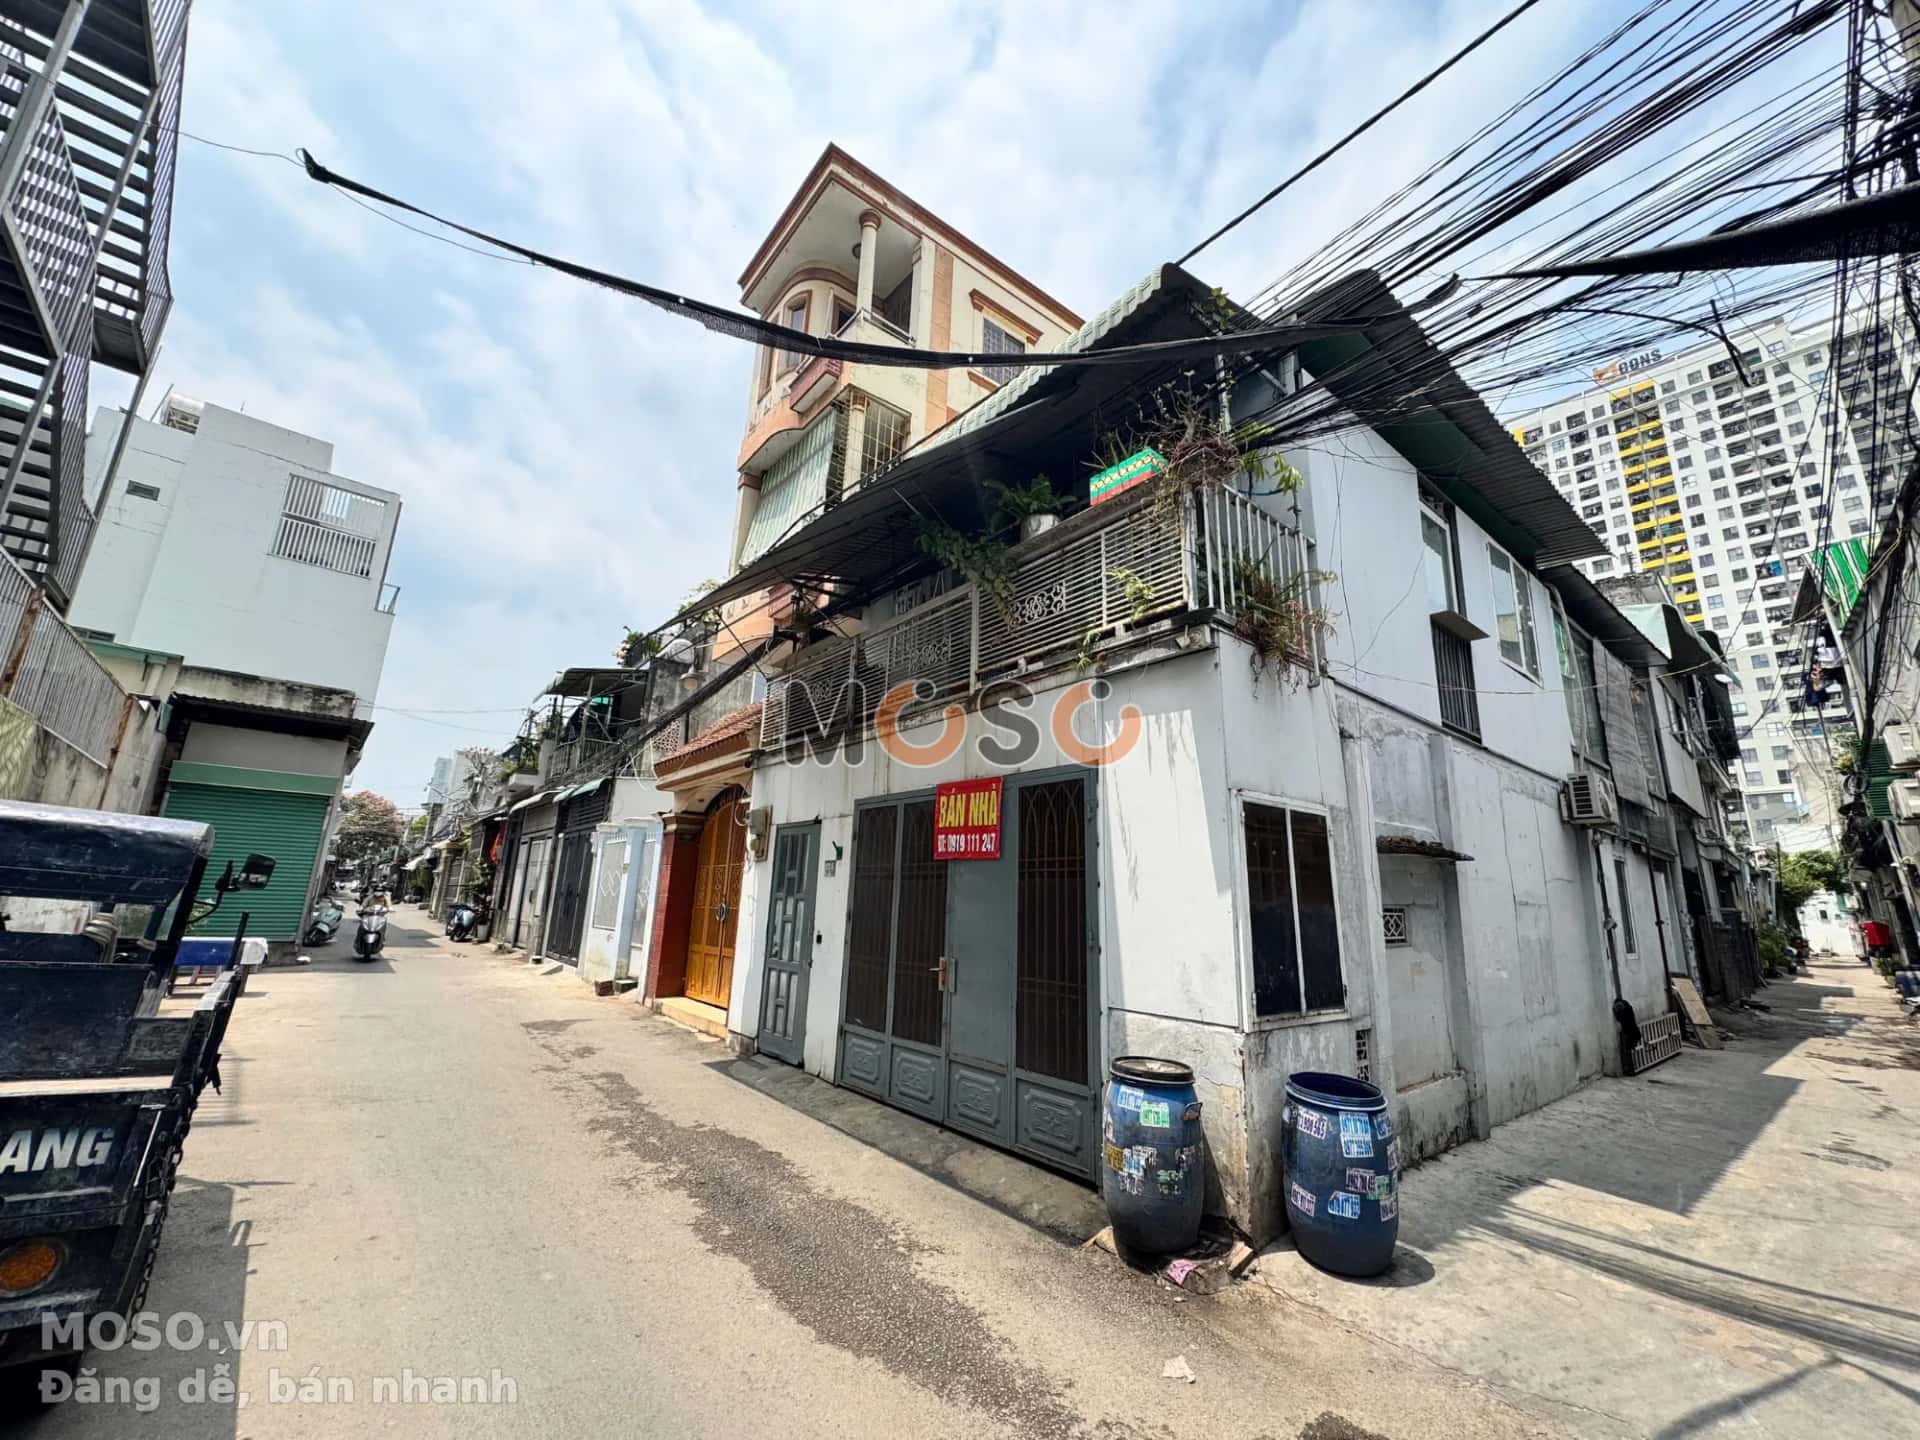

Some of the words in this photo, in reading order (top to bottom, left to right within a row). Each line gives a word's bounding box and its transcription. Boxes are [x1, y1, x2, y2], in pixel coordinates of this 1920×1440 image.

[938, 787, 966, 828] BÁN
[968, 783, 997, 826] NHÀ
[967, 833, 980, 852] 111
[981, 832, 996, 852] 247
